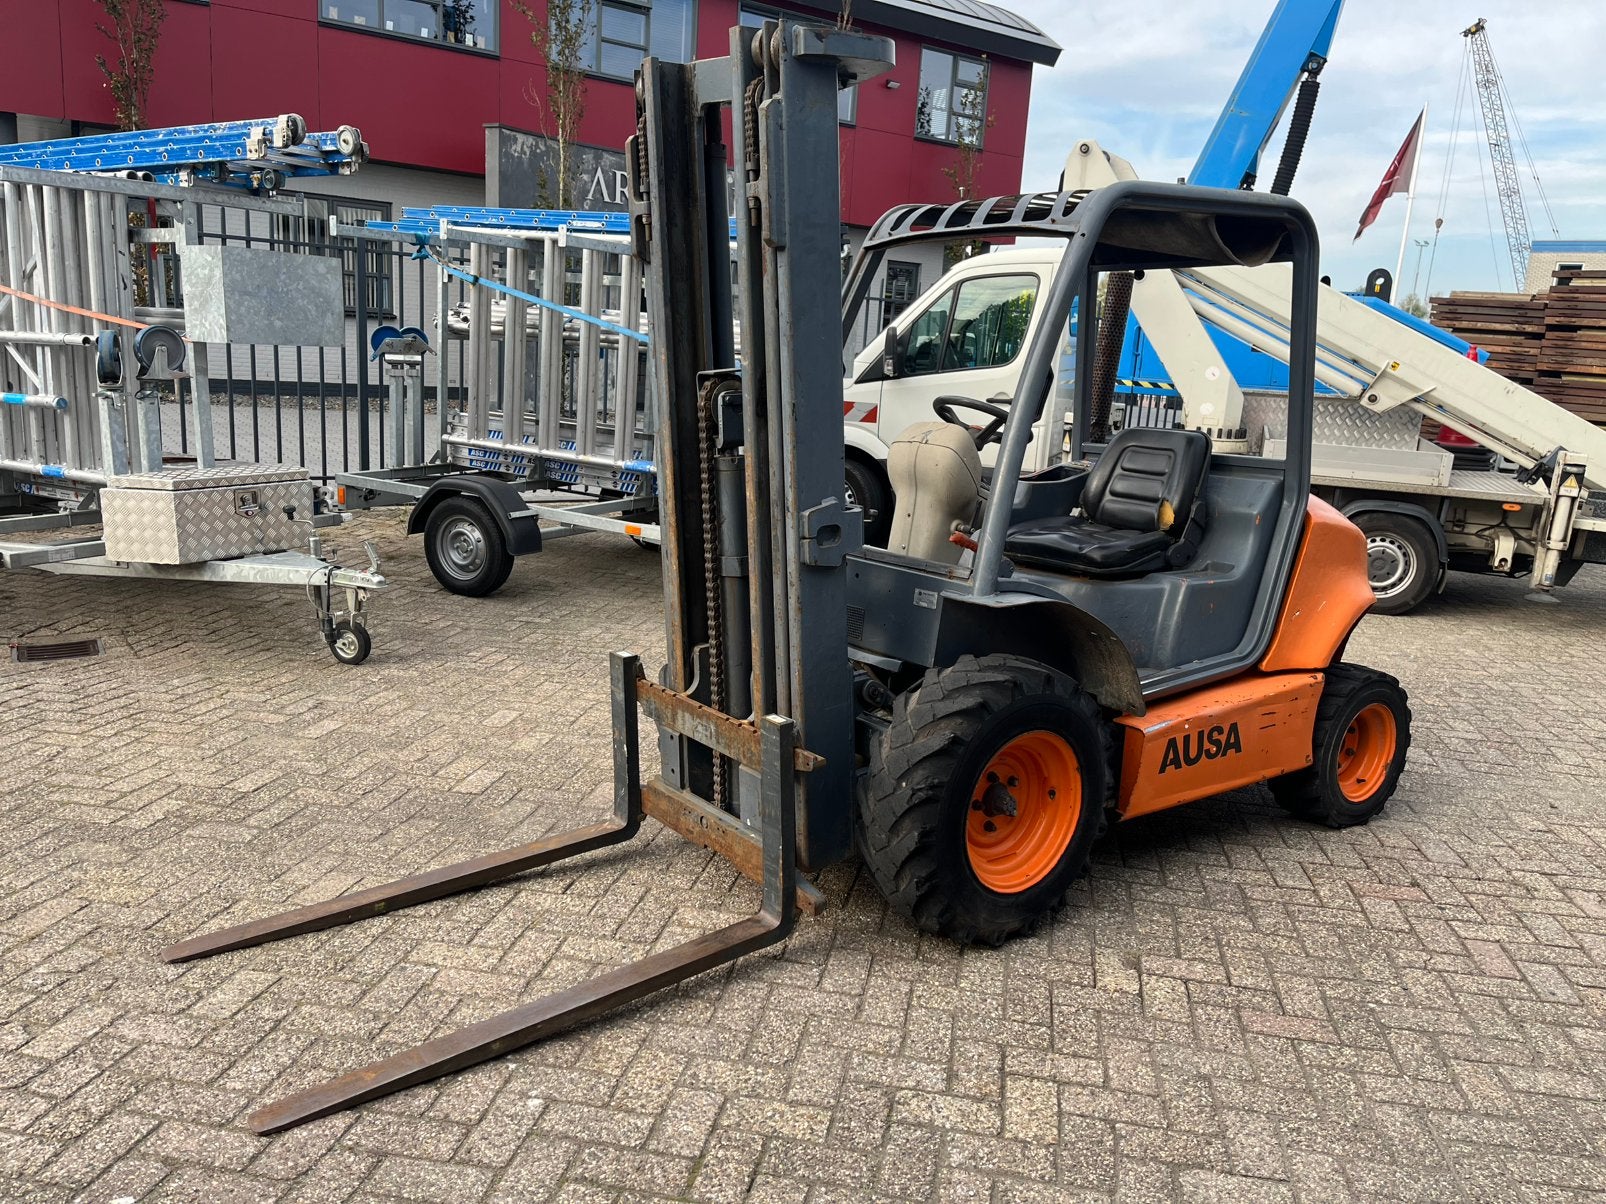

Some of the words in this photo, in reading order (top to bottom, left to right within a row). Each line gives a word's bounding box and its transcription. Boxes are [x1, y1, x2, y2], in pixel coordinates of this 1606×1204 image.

[470, 449, 485, 457] ASC
[471, 460, 486, 468] ASC
[546, 471, 562, 480] ASC
[1158, 722, 1242, 774] AUSA
